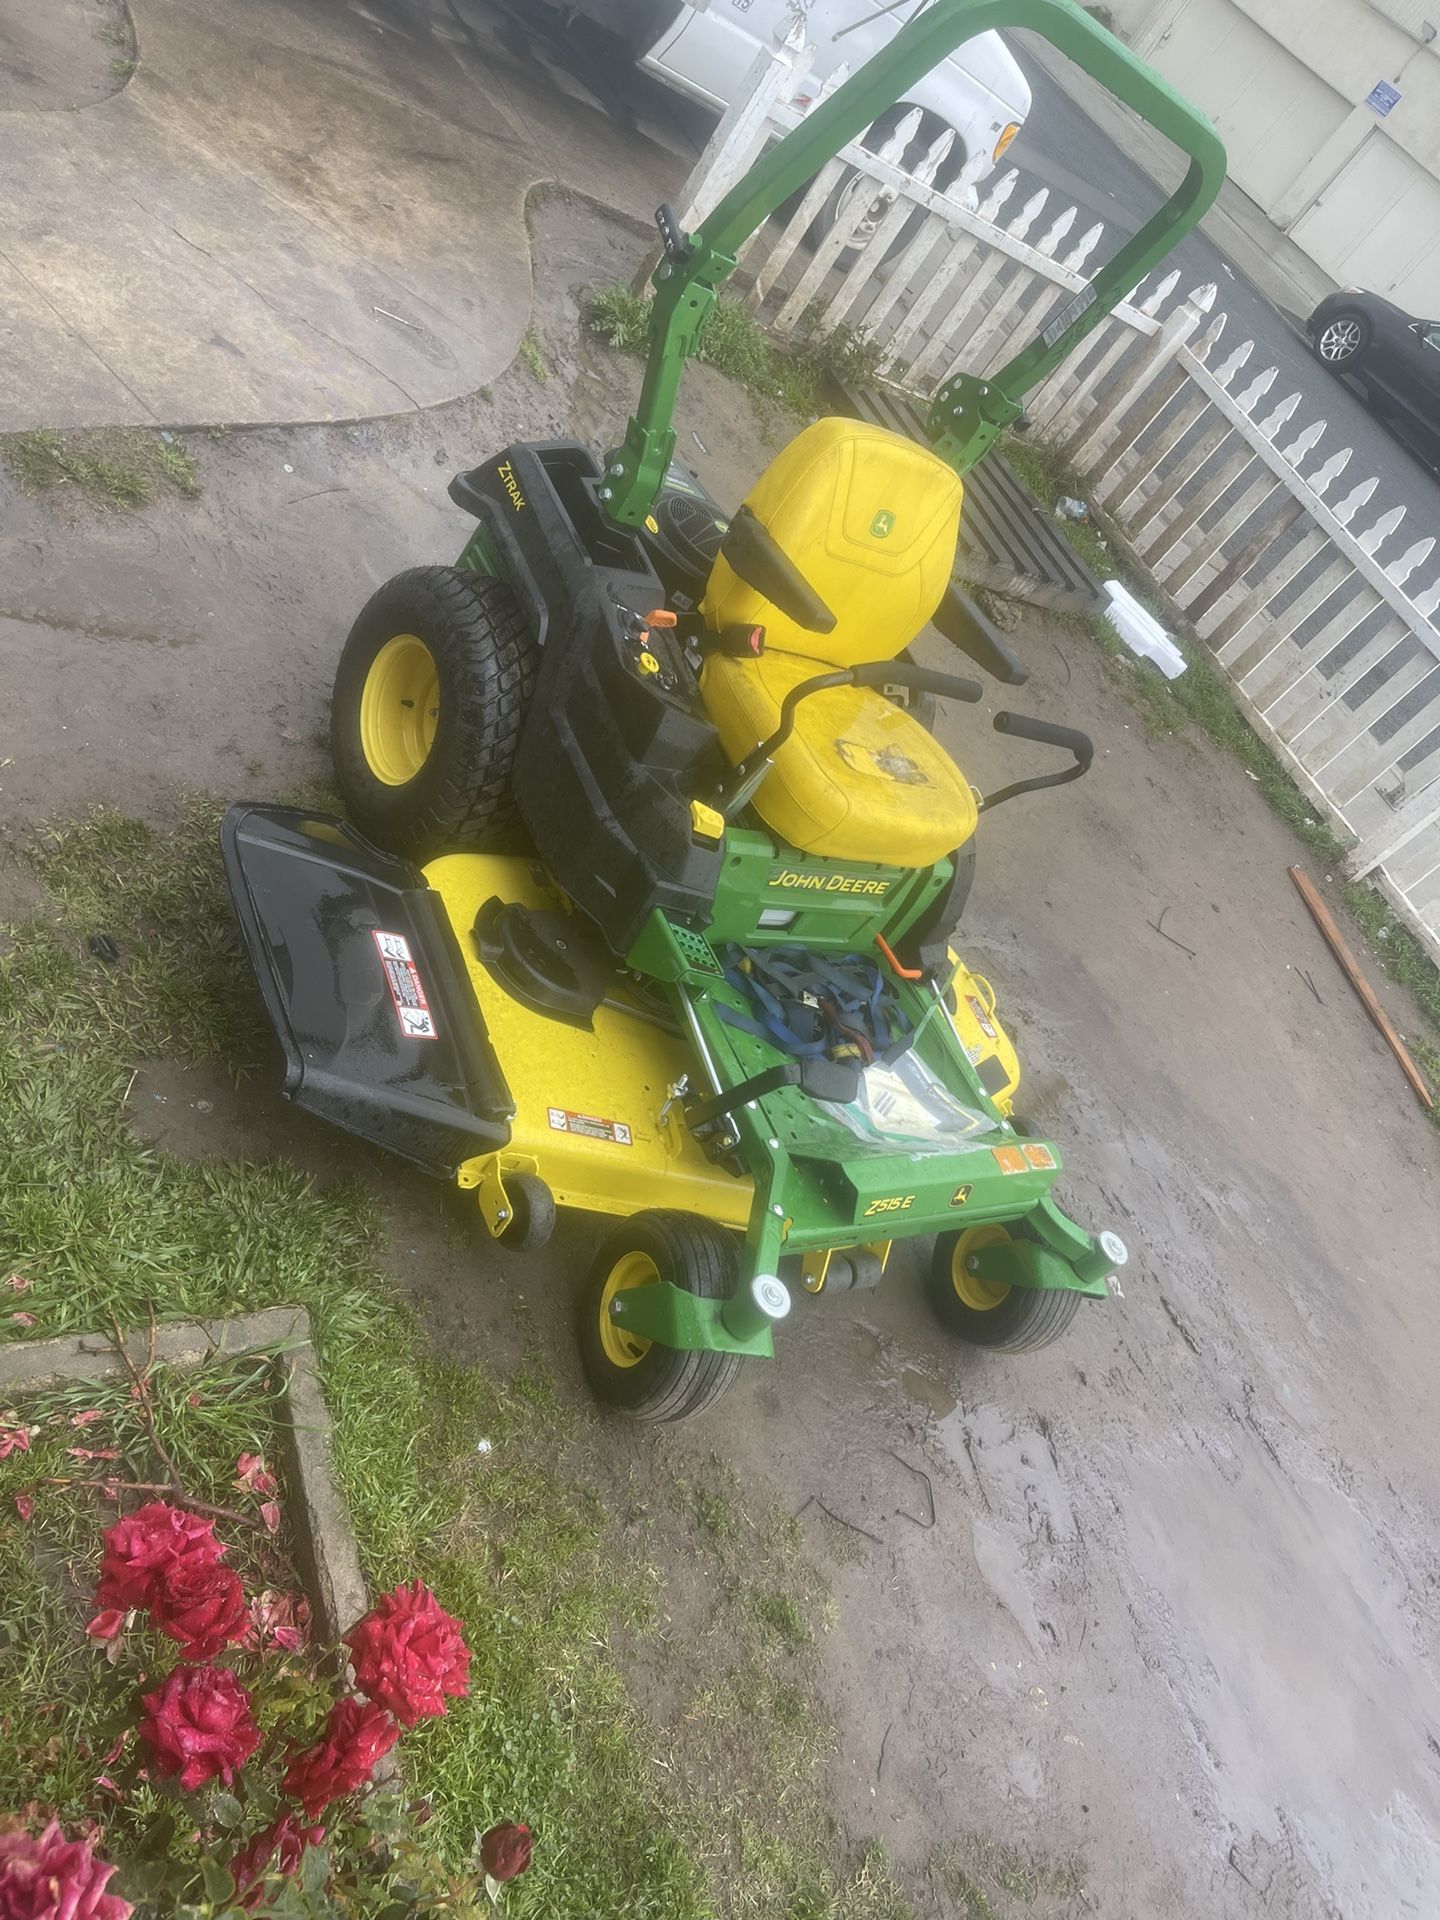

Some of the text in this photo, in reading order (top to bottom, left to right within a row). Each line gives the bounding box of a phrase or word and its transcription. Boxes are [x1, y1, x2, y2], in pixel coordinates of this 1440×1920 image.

[497, 460, 526, 512] ZTRAK
[768, 870, 890, 895] JOHN DEERE
[413, 975, 427, 1005] DANGER
